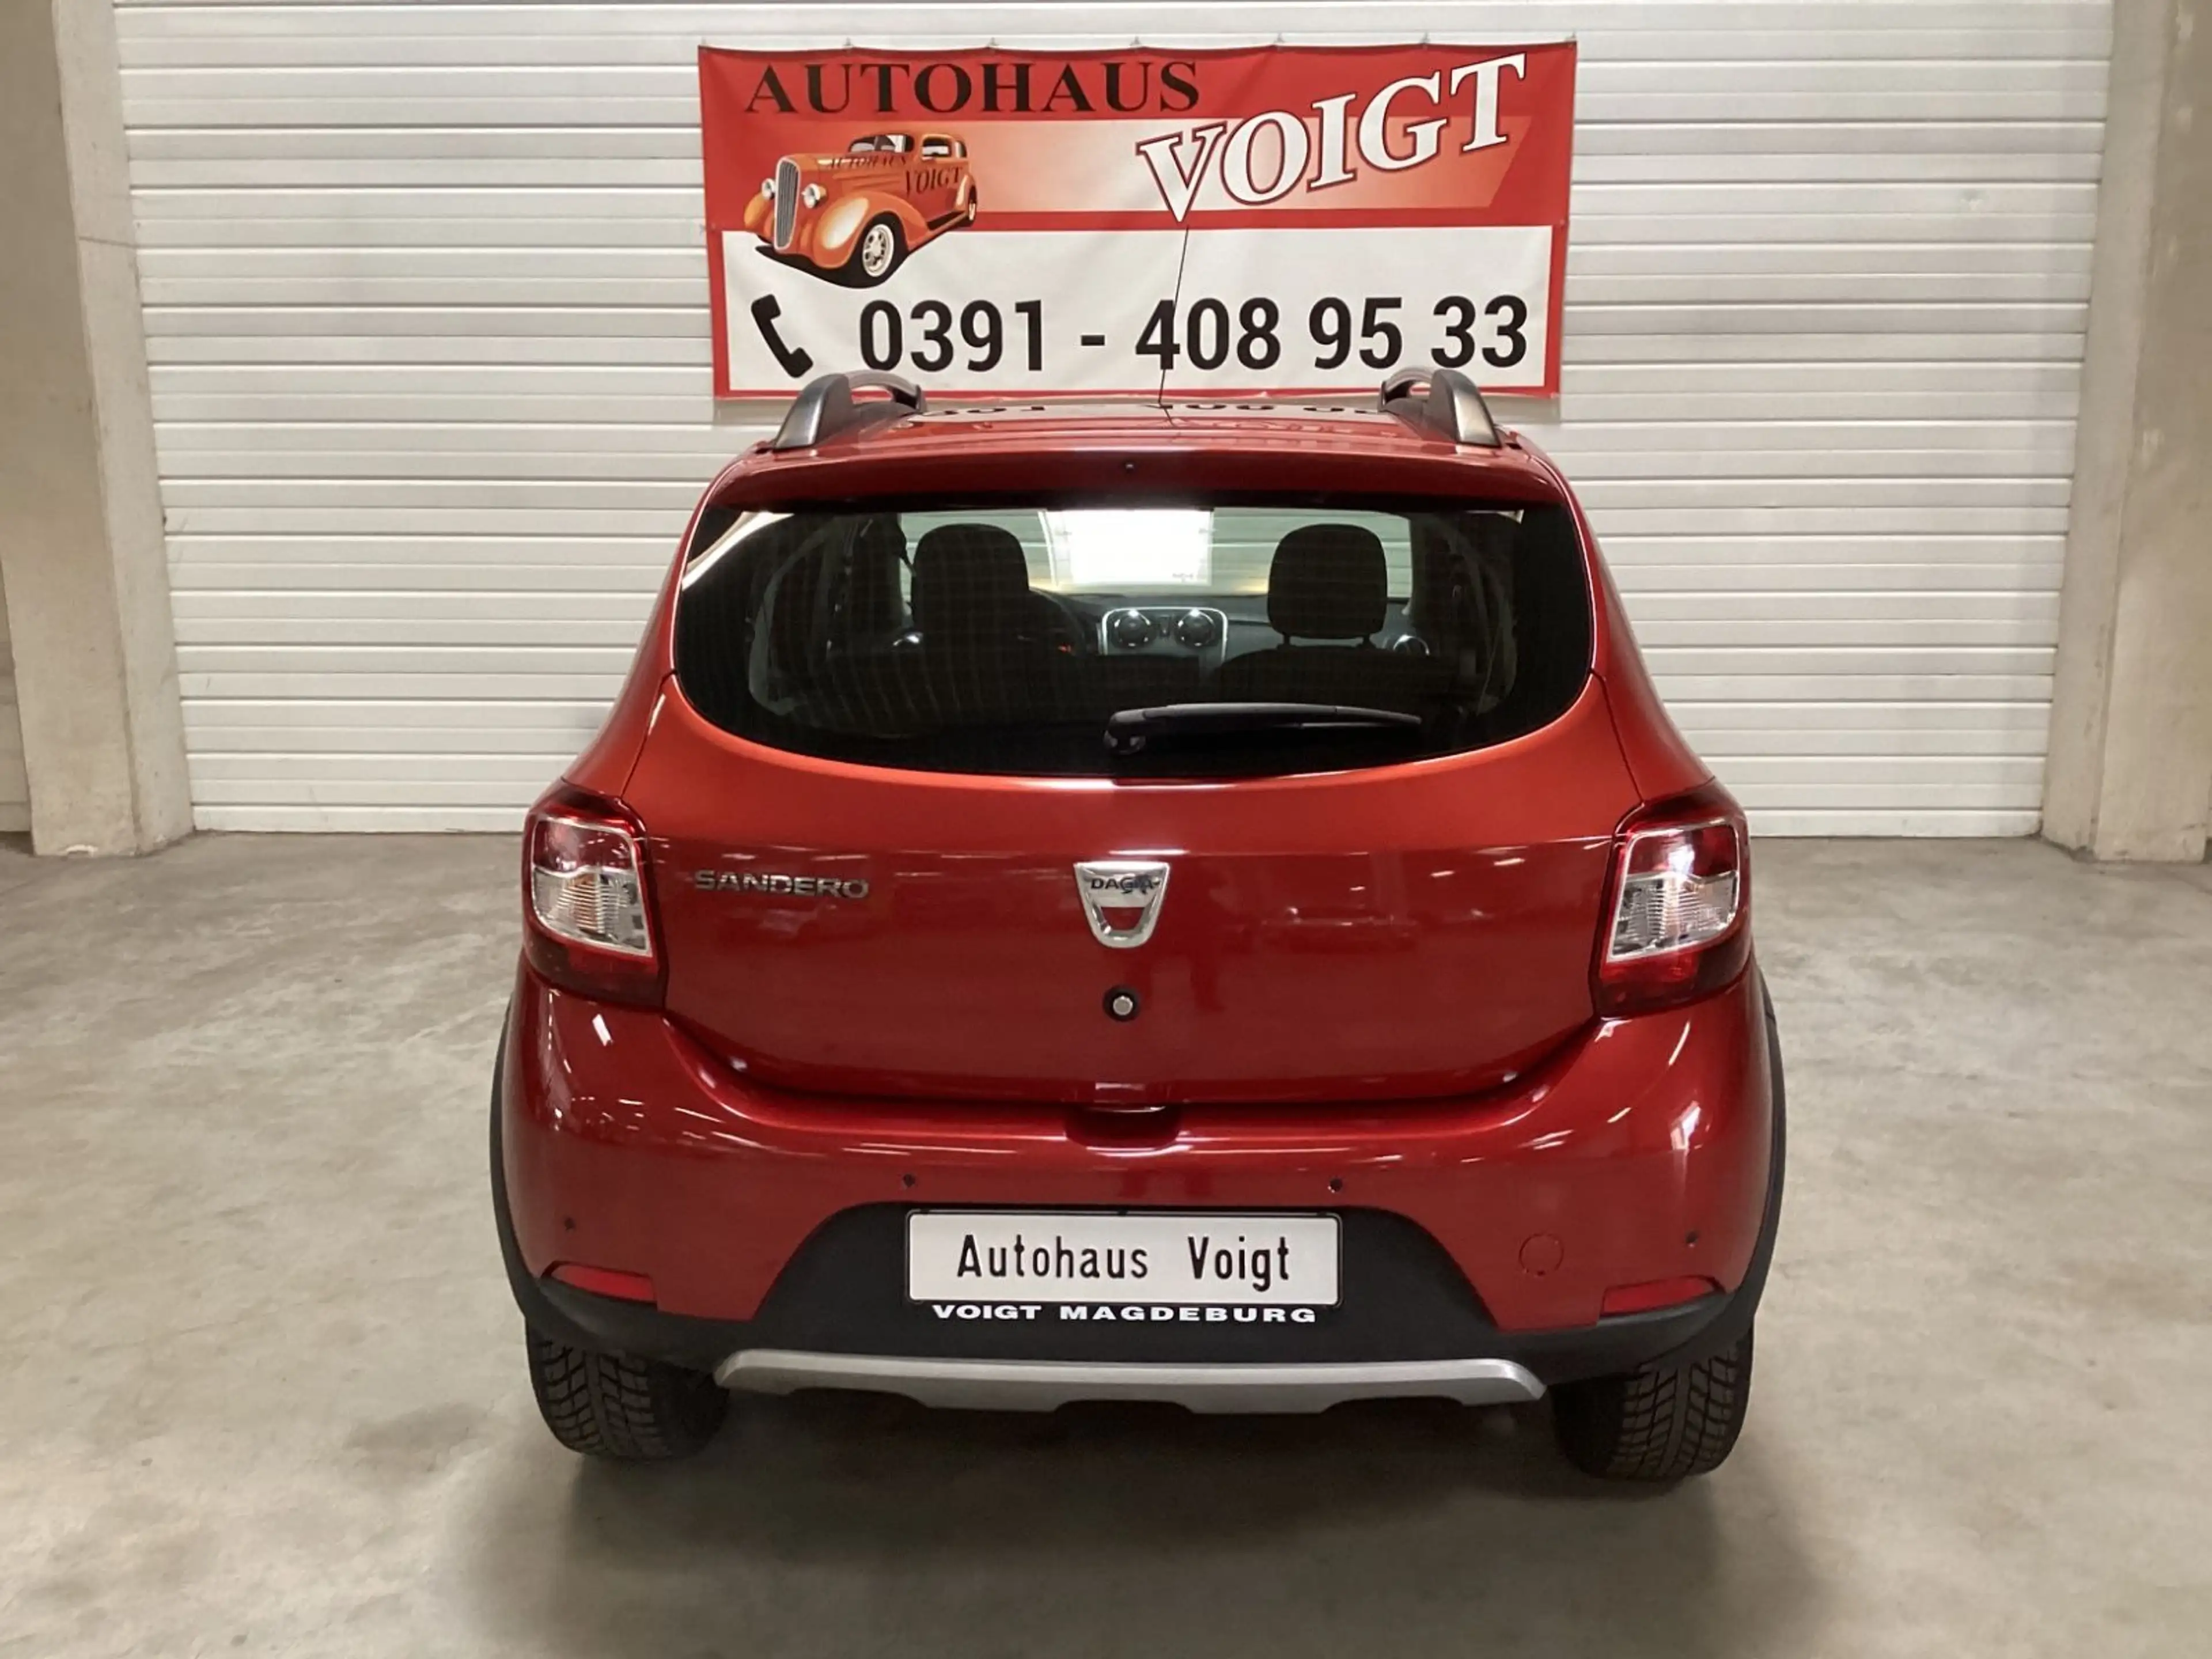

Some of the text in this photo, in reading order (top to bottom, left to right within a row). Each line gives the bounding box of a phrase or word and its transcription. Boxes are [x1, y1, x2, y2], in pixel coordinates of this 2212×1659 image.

[744, 61, 1200, 113] AUTOHAUS
[1135, 53, 1527, 223] VOIGT
[904, 166, 963, 197] VOIGT
[860, 300, 1042, 372] 0391
[1135, 297, 1281, 371] 408
[1309, 296, 1404, 370] 95
[1430, 294, 1528, 369] 33
[694, 870, 870, 899] SANDERO
[957, 1234, 1290, 1292] Autohaus Voigt
[932, 1304, 1317, 1323] VOIGT MAGDEBURG
